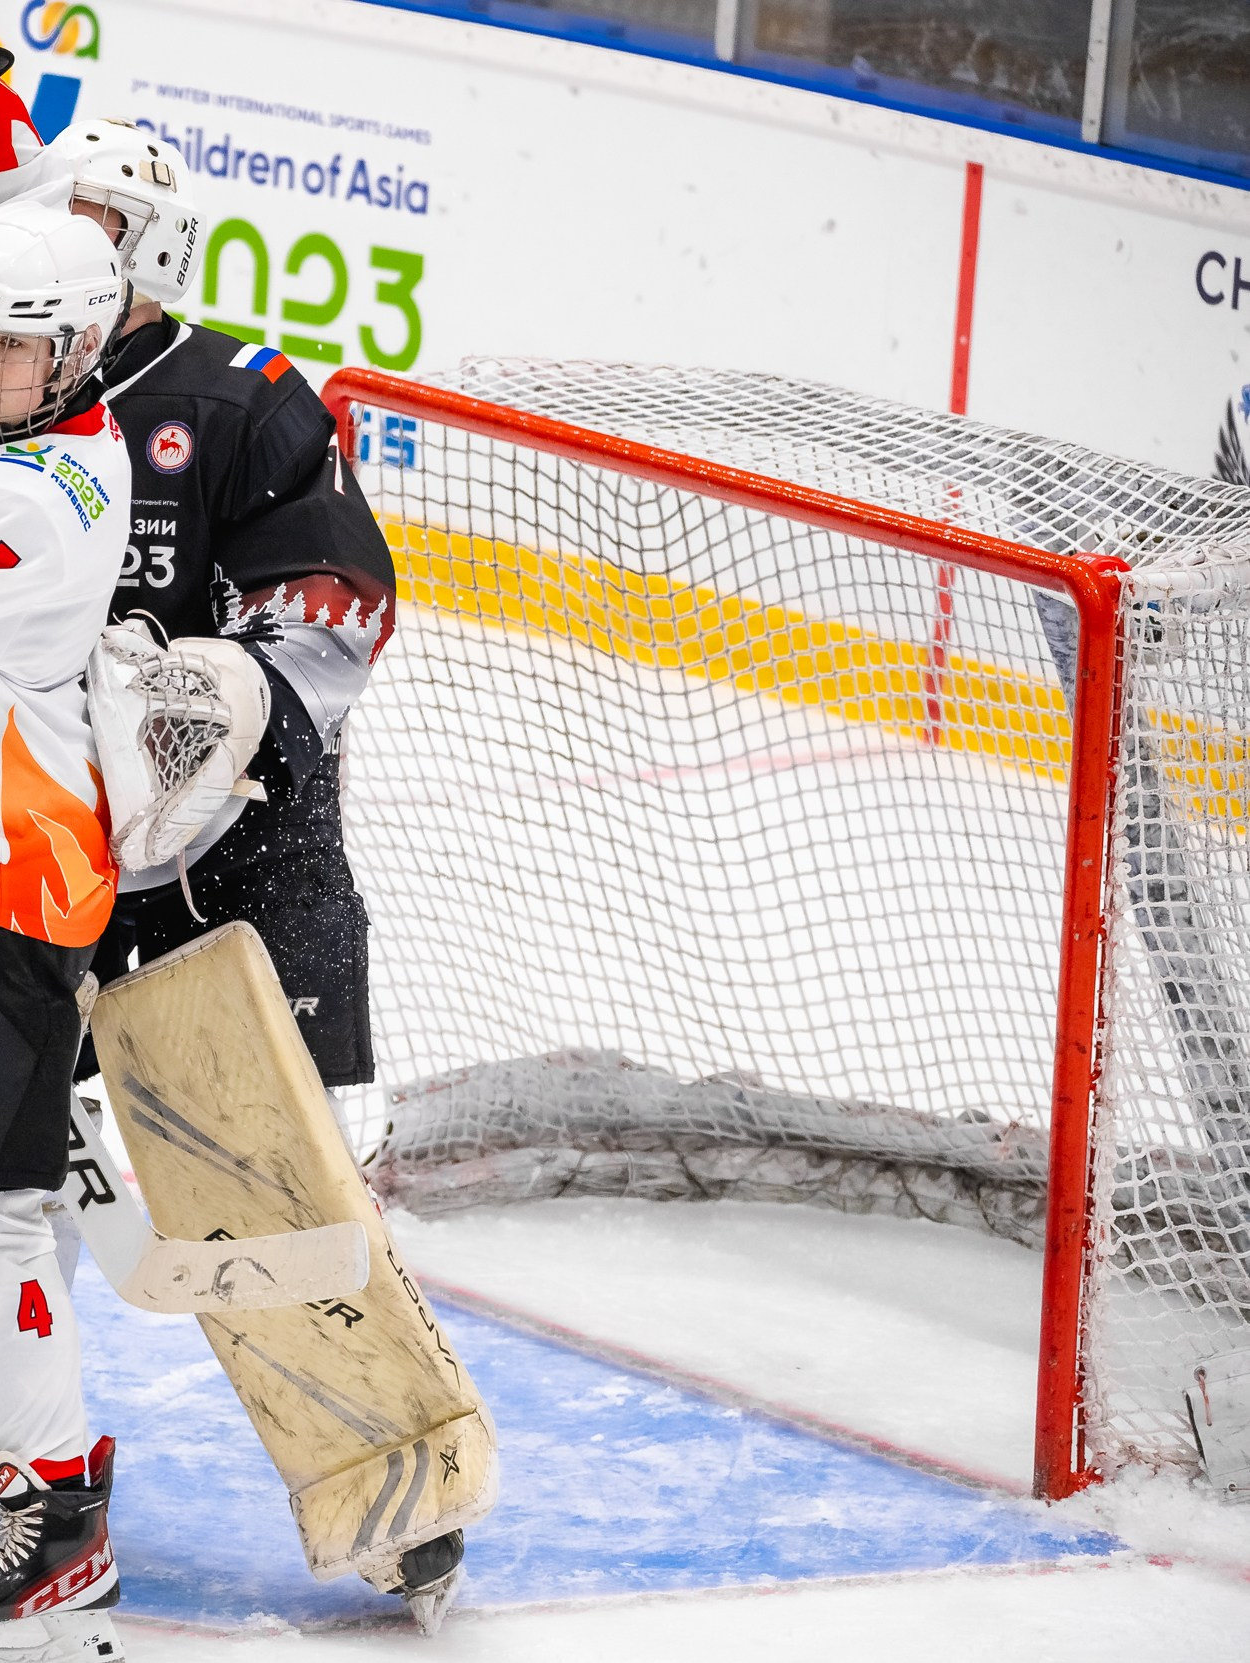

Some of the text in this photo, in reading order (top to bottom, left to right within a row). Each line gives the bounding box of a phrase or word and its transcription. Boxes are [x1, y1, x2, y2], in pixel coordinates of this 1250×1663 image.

[155, 83, 211, 105] WINTER
[215, 93, 326, 127] INTERNATIONAL
[328, 112, 382, 135] SPORTS
[383, 123, 433, 146] GAMES
[302, 153, 343, 198] of
[346, 158, 430, 215] Asia
[176, 216, 199, 287] BAUER
[87, 291, 118, 306] CCM
[167, 217, 425, 373] 023
[50, 472, 92, 533] КУЗБАСС
[55, 461, 105, 520] 2023
[60, 452, 111, 506] Дети Азии
[162, 499, 179, 507] ИГРЫ
[130, 518, 177, 536] зии
[118, 544, 176, 588] 23
[17, 1279, 53, 1338] 4
[18, 1538, 113, 1619] CCM
